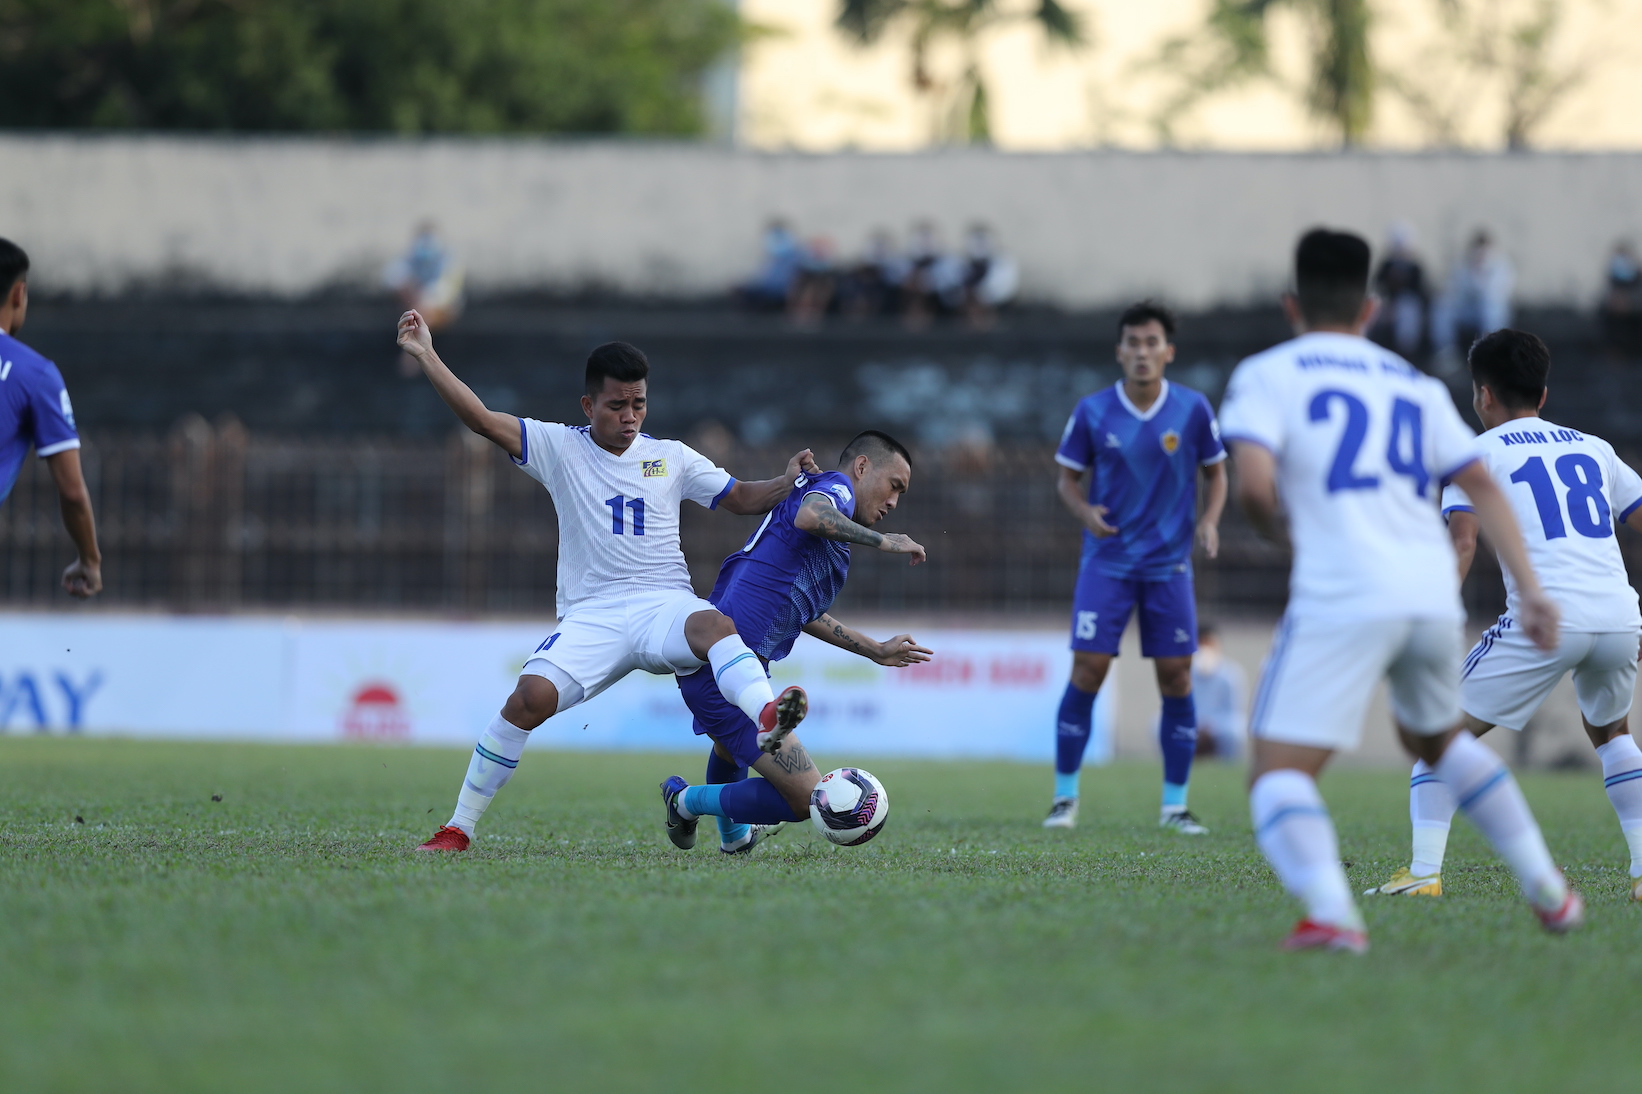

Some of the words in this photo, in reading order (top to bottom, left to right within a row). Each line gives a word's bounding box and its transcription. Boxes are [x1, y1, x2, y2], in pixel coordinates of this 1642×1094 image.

[1307, 386, 1429, 499] 24
[605, 495, 645, 536] 11
[1510, 453, 1613, 541] 18
[1075, 609, 1099, 641] 15
